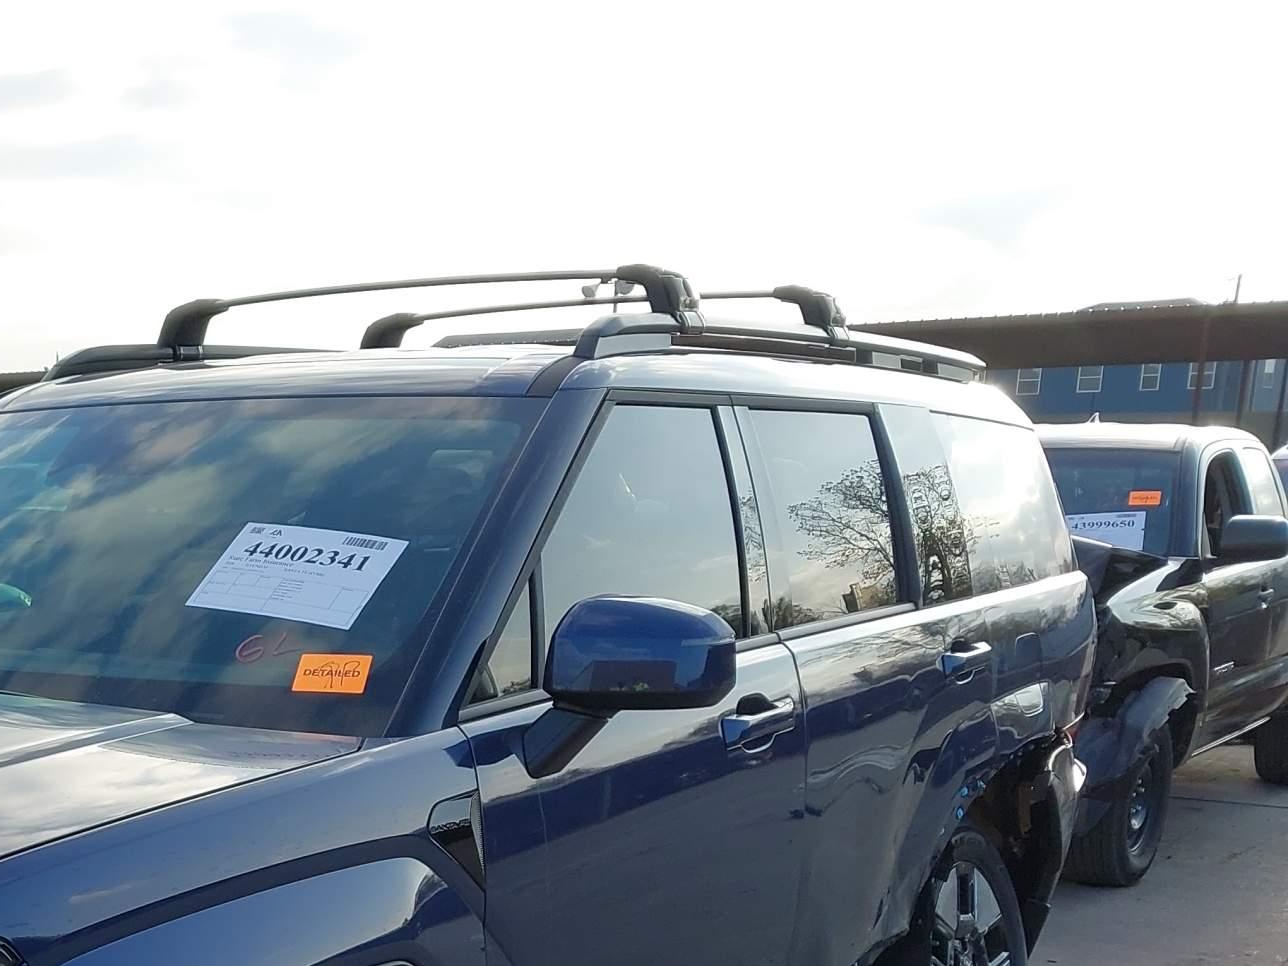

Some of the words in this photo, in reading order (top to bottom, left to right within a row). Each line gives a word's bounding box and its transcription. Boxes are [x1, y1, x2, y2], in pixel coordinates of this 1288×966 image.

[1072, 519, 1135, 530] 43999650
[244, 541, 371, 572] 44002341
[303, 668, 361, 678] DETAILED
